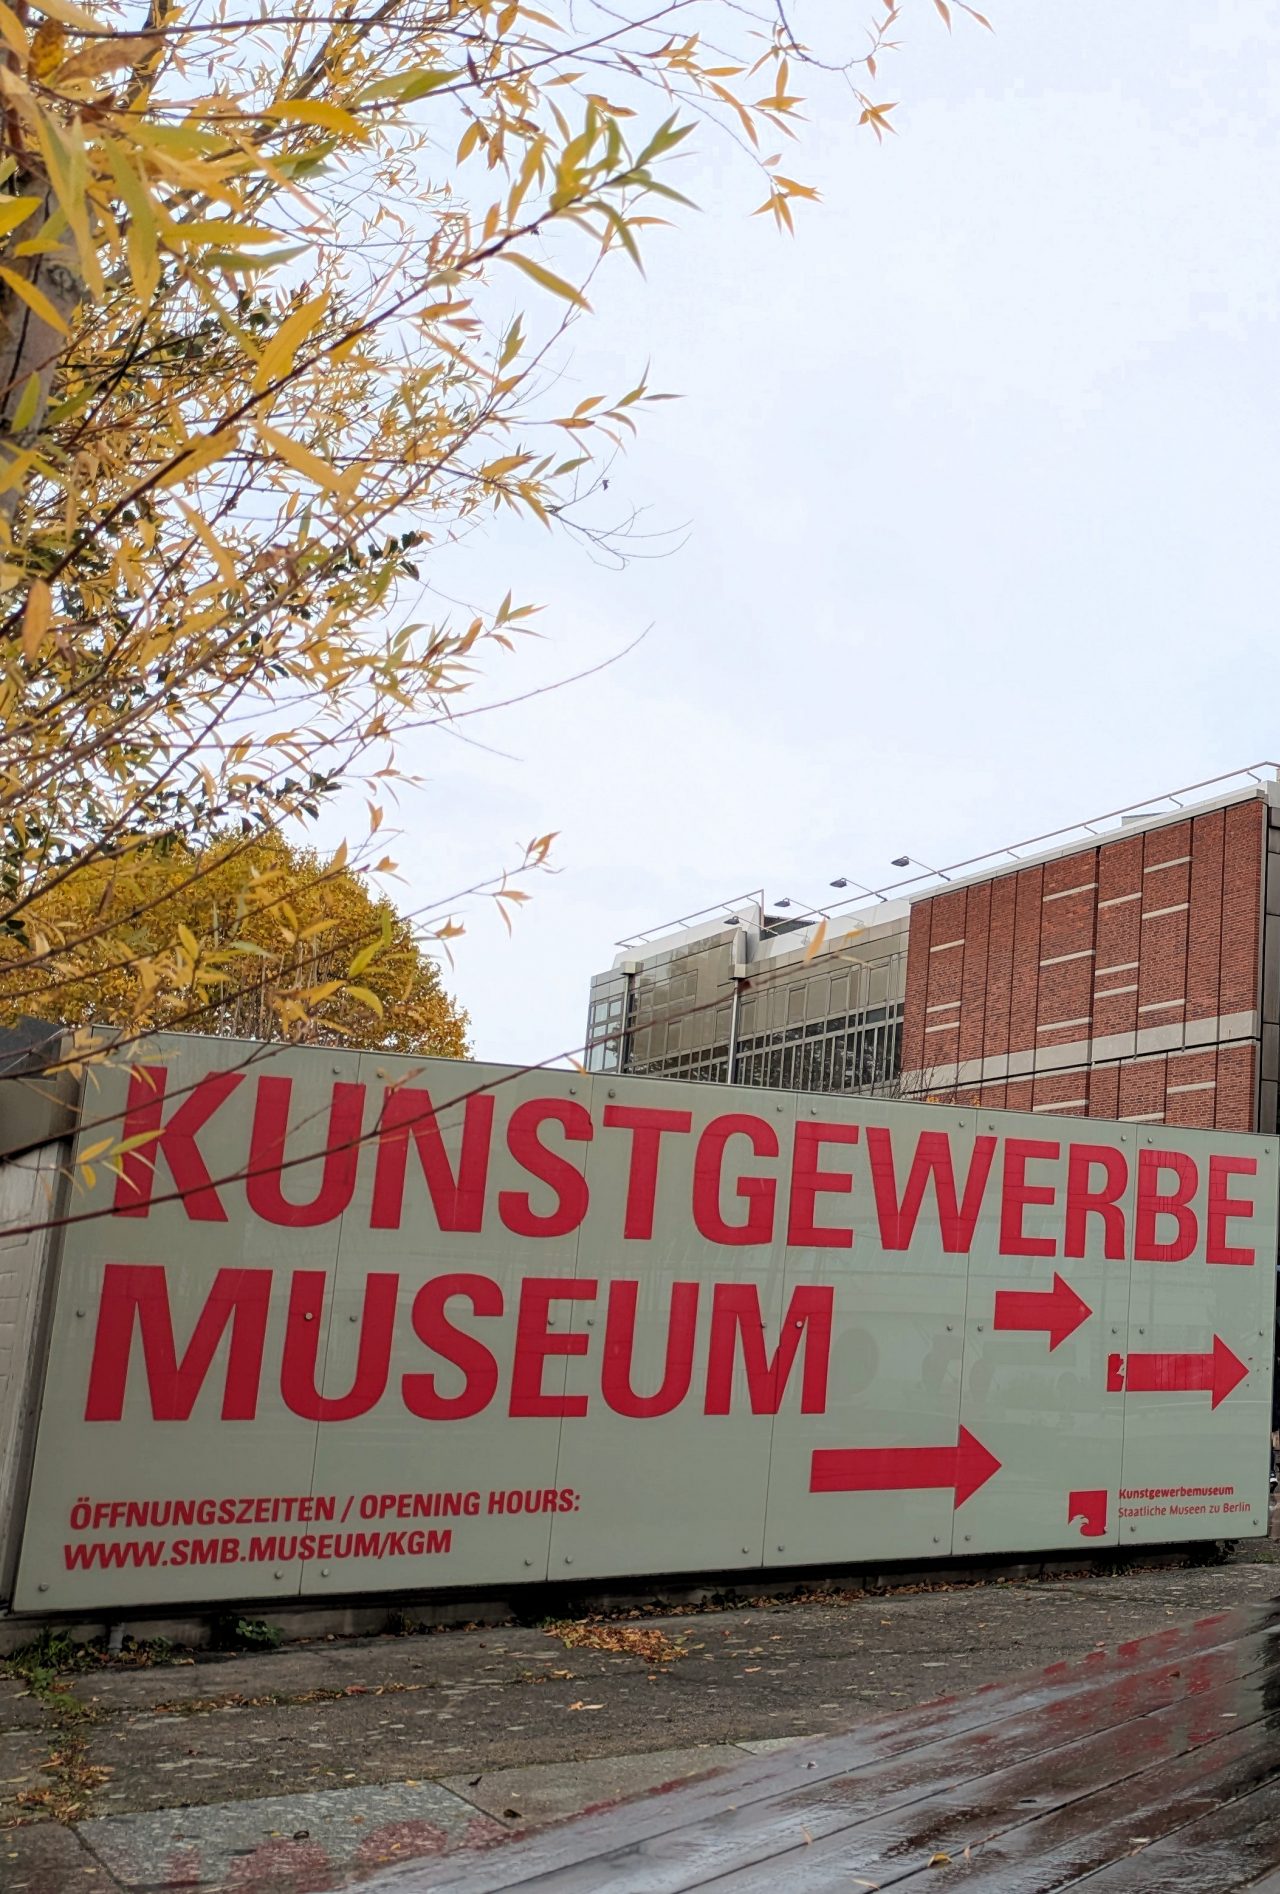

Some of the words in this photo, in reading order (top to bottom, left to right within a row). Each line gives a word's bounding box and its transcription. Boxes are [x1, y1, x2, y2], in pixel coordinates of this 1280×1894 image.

[110, 1064, 1258, 1266] KUNSTGEWERBE
[83, 1263, 836, 1423] MUSEUM
[69, 1496, 336, 1530] ÖFFNUNGSZEITEN
[340, 1496, 355, 1523] /
[359, 1490, 480, 1520] OPENING
[487, 1488, 581, 1515] HOURS:
[1117, 1506, 1167, 1518] Staatliche
[1169, 1503, 1206, 1516] Museen
[1209, 1504, 1220, 1514] zu
[1223, 1501, 1251, 1513] Berlin
[1118, 1486, 1233, 1500] Kunstgewerbemuseum
[63, 1529, 453, 1571] WWW.SMB.MUSEUM/KGM
